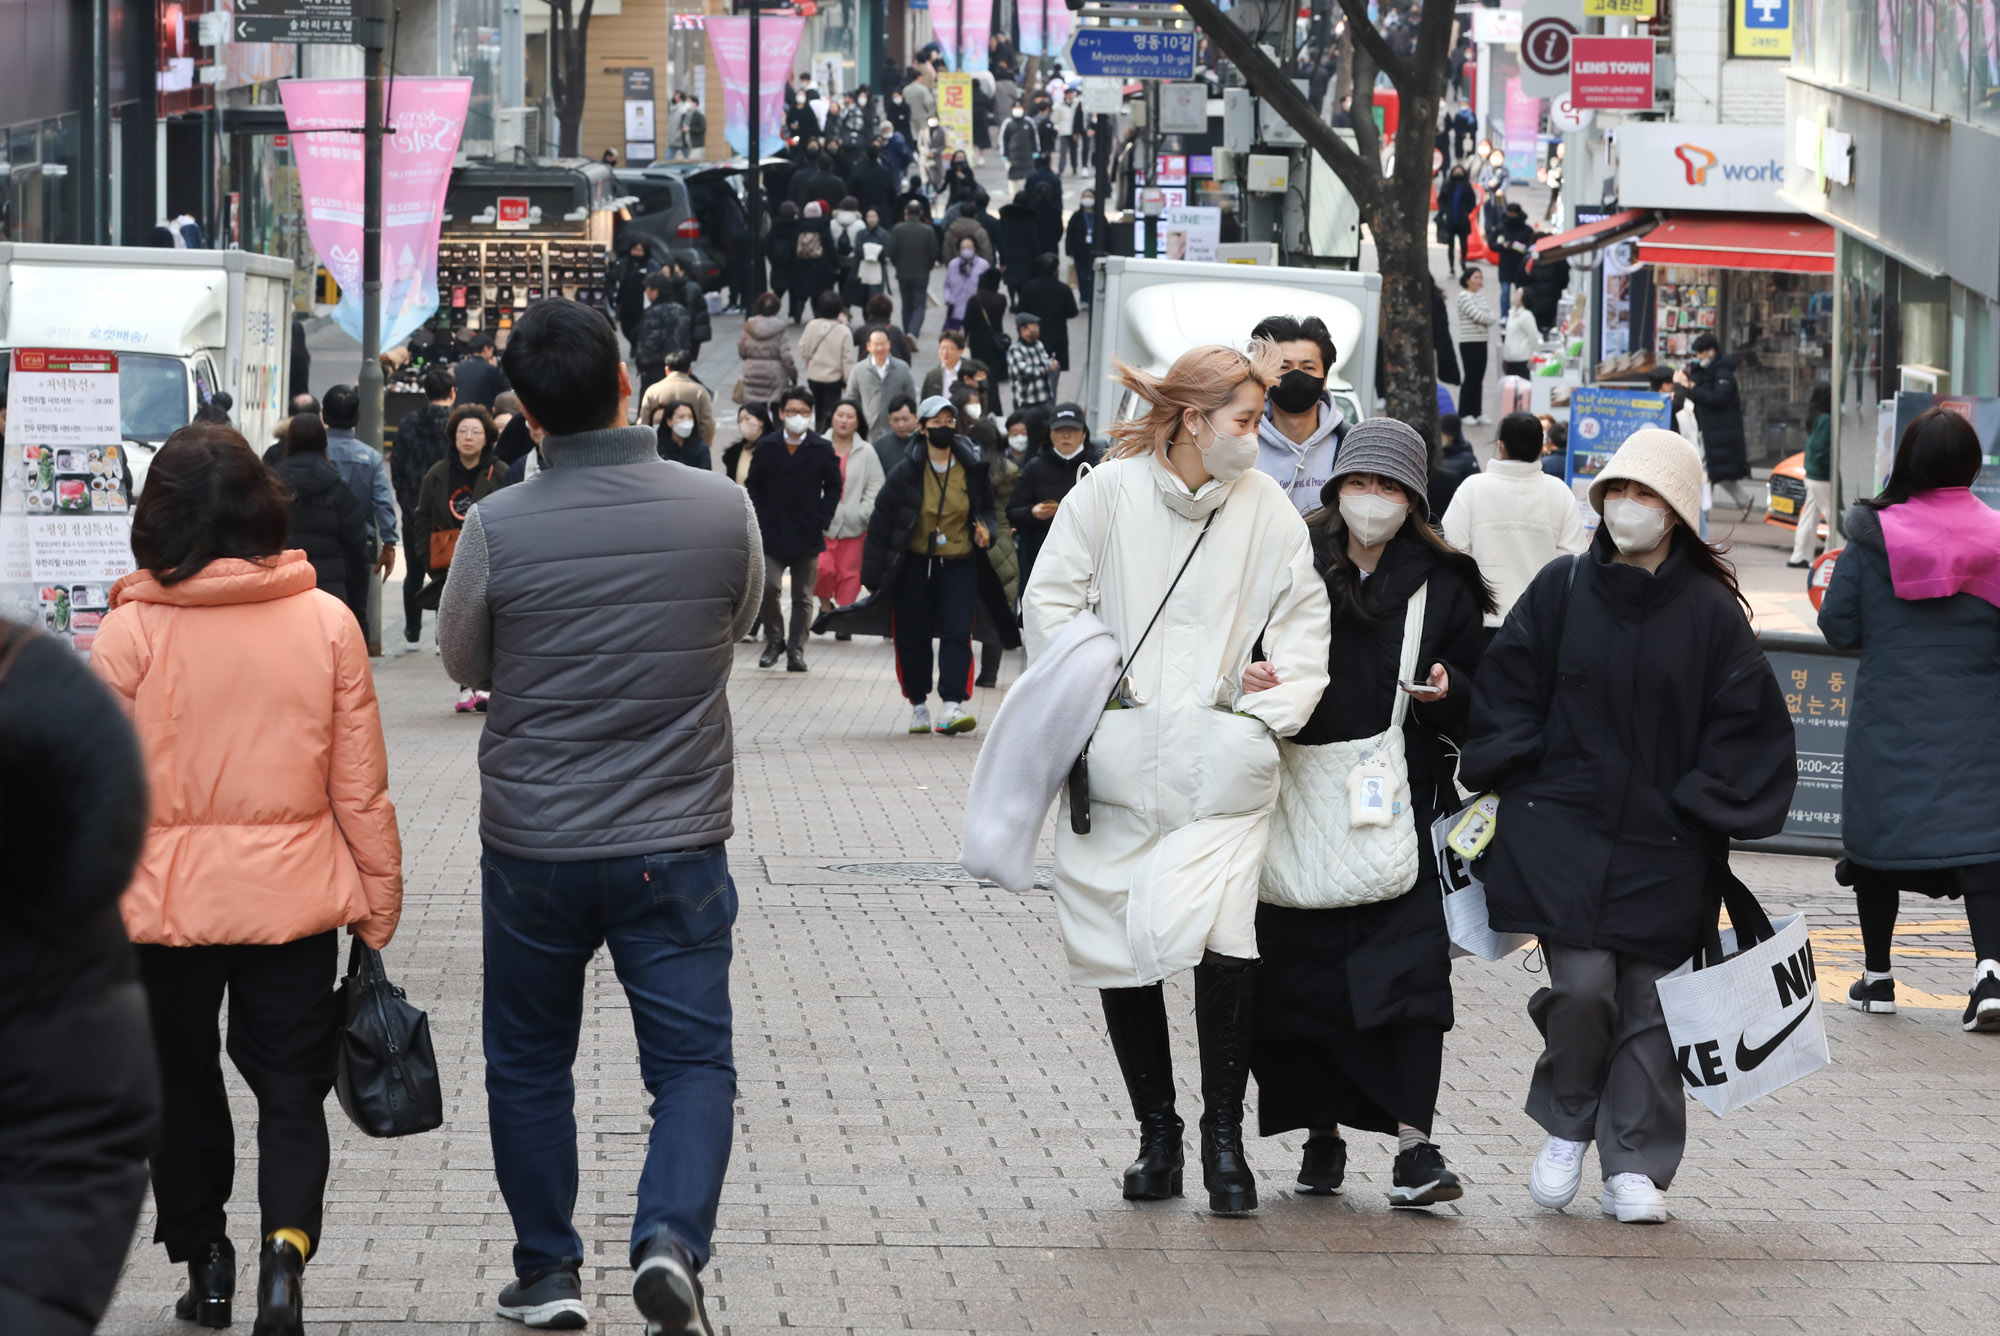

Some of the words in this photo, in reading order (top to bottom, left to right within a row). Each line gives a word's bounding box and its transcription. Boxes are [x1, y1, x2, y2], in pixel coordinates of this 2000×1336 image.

[1133, 34, 1191, 52] 명동10길
[1092, 52, 1159, 65] Myeongdong
[1162, 54, 1191, 65] 10-gil
[1575, 61, 1609, 75] LENS
[1609, 62, 1651, 75] TOWN
[1579, 86, 1609, 95] CONTACT
[1610, 86, 1625, 95] LENS
[1625, 86, 1645, 95] STORE
[944, 85, 965, 109] 足
[1172, 213, 1200, 225] LINE
[47, 378, 88, 391] 저녁특선
[22, 396, 46, 405] 무한리필
[48, 396, 72, 405] 샤브샤브
[1577, 395, 1595, 404] BLUE
[24, 424, 34, 433] 한우
[47, 522, 67, 536] 평일
[72, 522, 113, 536] 점심특선
[36, 559, 60, 568] 무한리필
[62, 559, 87, 567] 샤브샤브
